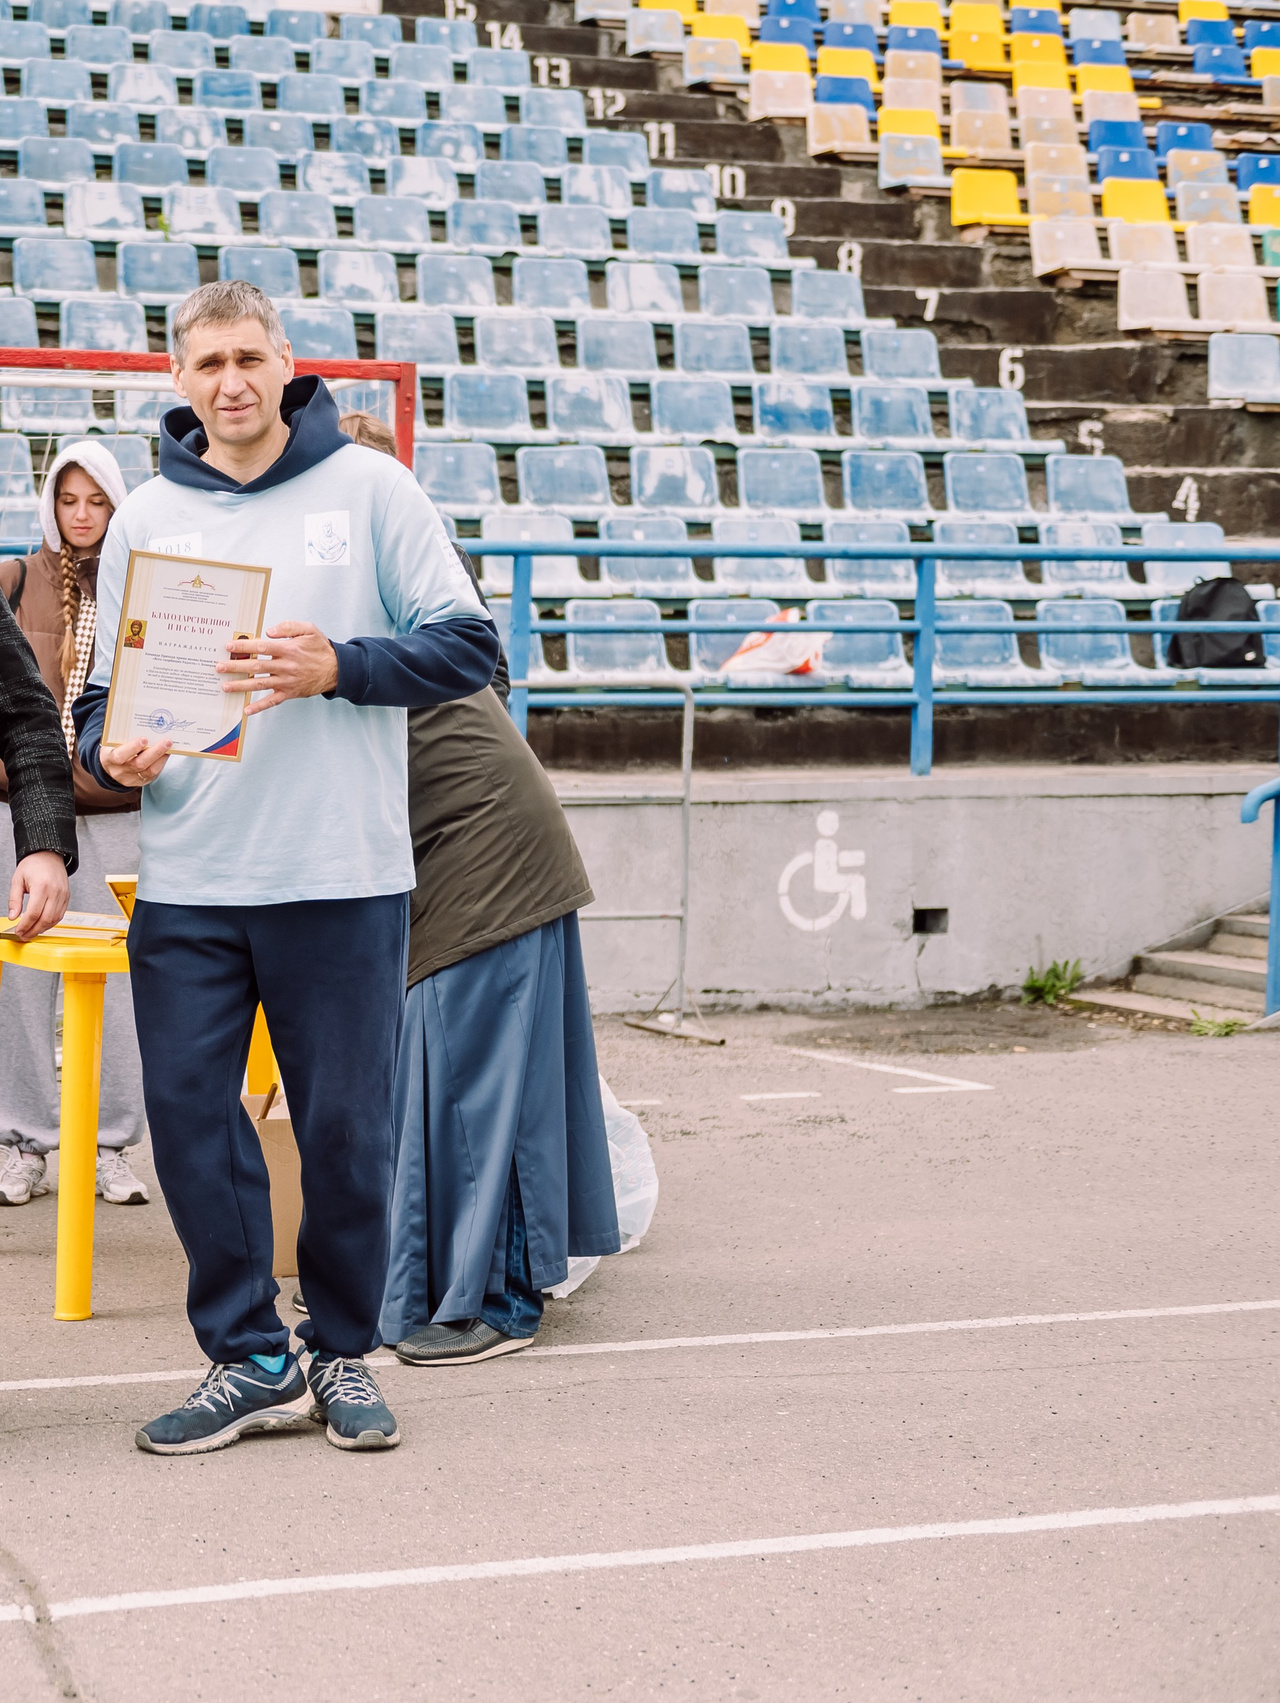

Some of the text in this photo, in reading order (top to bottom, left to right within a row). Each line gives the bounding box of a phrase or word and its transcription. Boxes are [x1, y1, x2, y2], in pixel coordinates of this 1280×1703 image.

[444, 0, 477, 22] 15
[485, 20, 524, 50] 14
[533, 57, 571, 88] 13
[587, 87, 627, 120] 12
[643, 122, 676, 160] 11
[705, 164, 746, 199] 10
[771, 197, 797, 237] 9
[837, 241, 864, 278] 8
[914, 288, 940, 322] 7
[999, 348, 1025, 391] 6
[1172, 476, 1200, 522] 4
[151, 611, 232, 628] БЛАГОДАРСТВЕННОЕ
[167, 623, 214, 635] ПИСЬМО
[158, 641, 217, 652] НАГРАЖДАЕТСЯ
